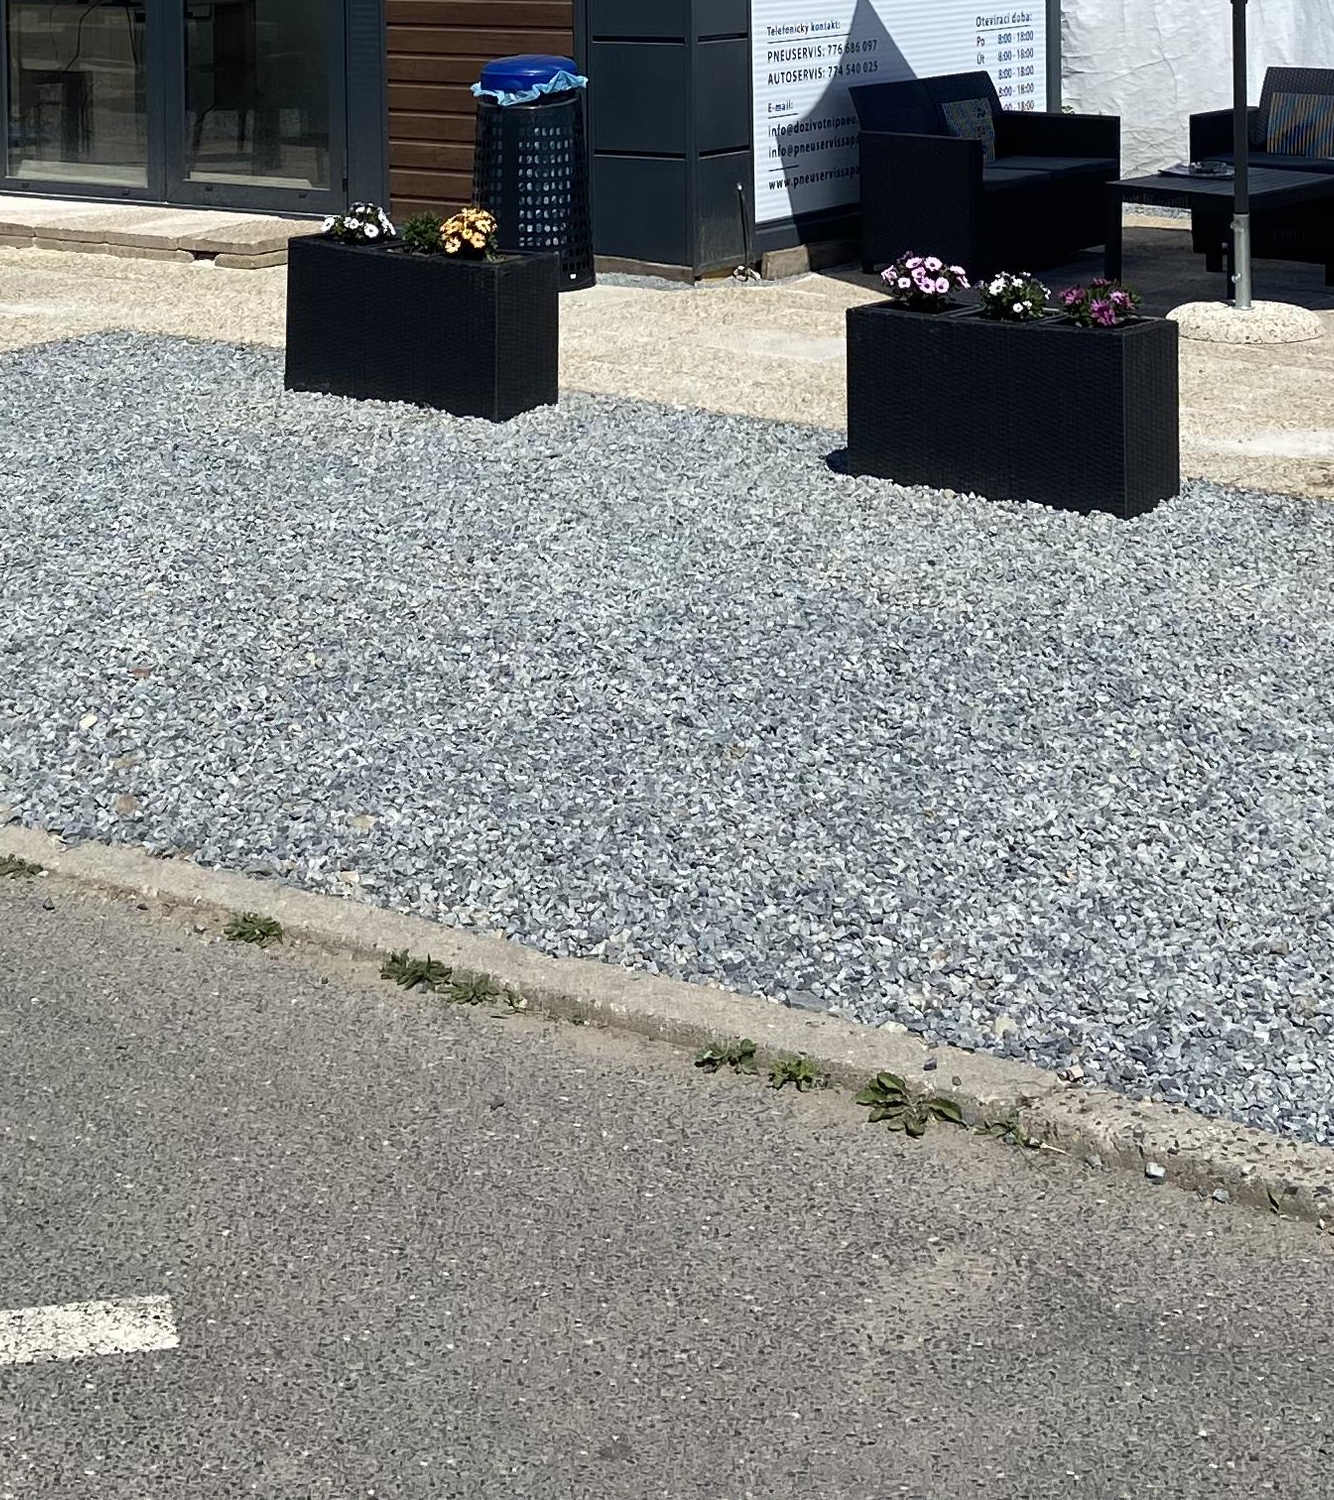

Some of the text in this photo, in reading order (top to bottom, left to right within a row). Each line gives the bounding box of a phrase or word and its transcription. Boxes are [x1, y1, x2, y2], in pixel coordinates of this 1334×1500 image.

[811, 20, 841, 32] kontakt:
[976, 36, 986, 47] Po
[998, 33, 1012, 44] 8:00
[1017, 30, 1034, 42] 18:00
[767, 45, 825, 63] PNEUSERVIS:
[828, 44, 842, 56] 776
[1017, 48, 1034, 60] 18:00
[767, 67, 825, 85] AUTOSERVIS:
[828, 65, 843, 78] 774
[846, 63, 861, 75] 540
[768, 100, 794, 112] E-mail:
